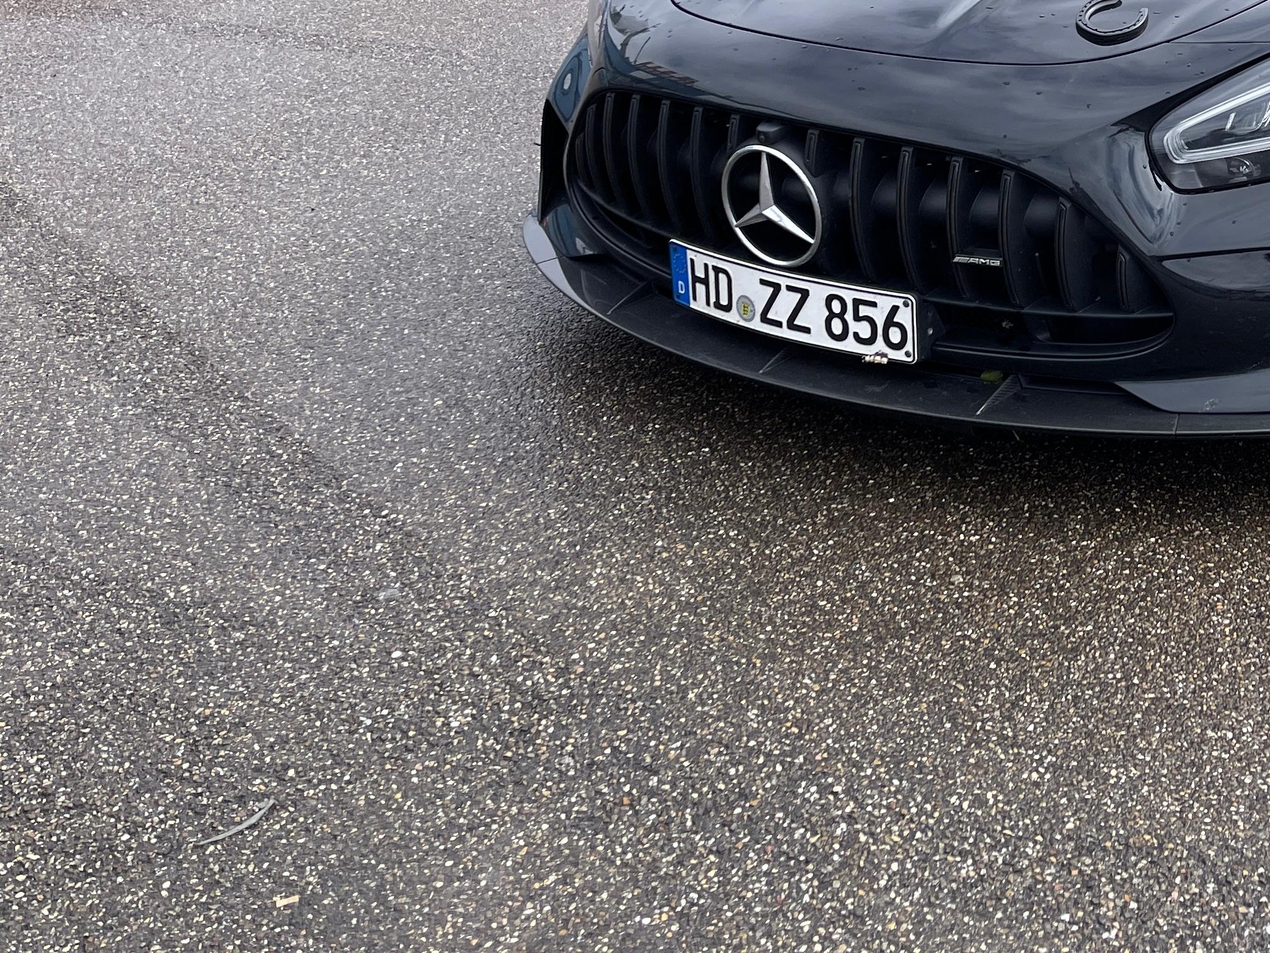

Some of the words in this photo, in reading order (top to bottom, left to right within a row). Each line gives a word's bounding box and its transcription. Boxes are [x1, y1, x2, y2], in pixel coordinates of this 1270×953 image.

[965, 257, 1001, 267] AMG
[678, 281, 686, 295] D
[690, 257, 733, 313] HD
[759, 278, 812, 335] ZZ
[824, 293, 909, 351] 856
